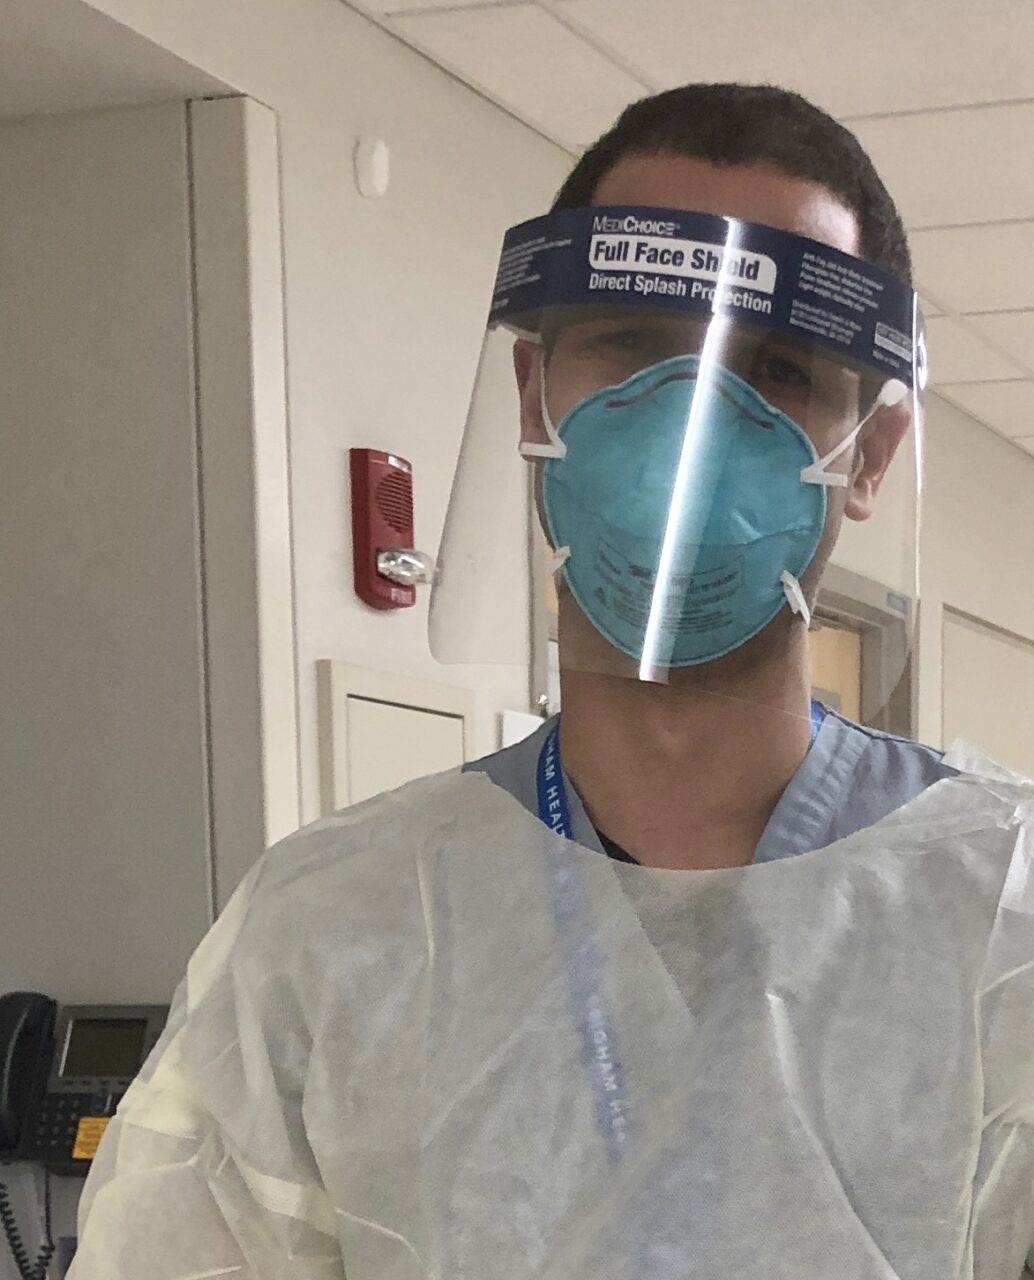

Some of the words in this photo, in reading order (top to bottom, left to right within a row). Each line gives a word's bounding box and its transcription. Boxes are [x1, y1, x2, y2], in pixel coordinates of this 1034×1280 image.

[593, 240, 630, 262] Full
[634, 241, 685, 267] Face
[690, 248, 760, 281] Sheld
[589, 272, 631, 291] Direct
[634, 274, 687, 296] Splash
[690, 281, 772, 314] Proection
